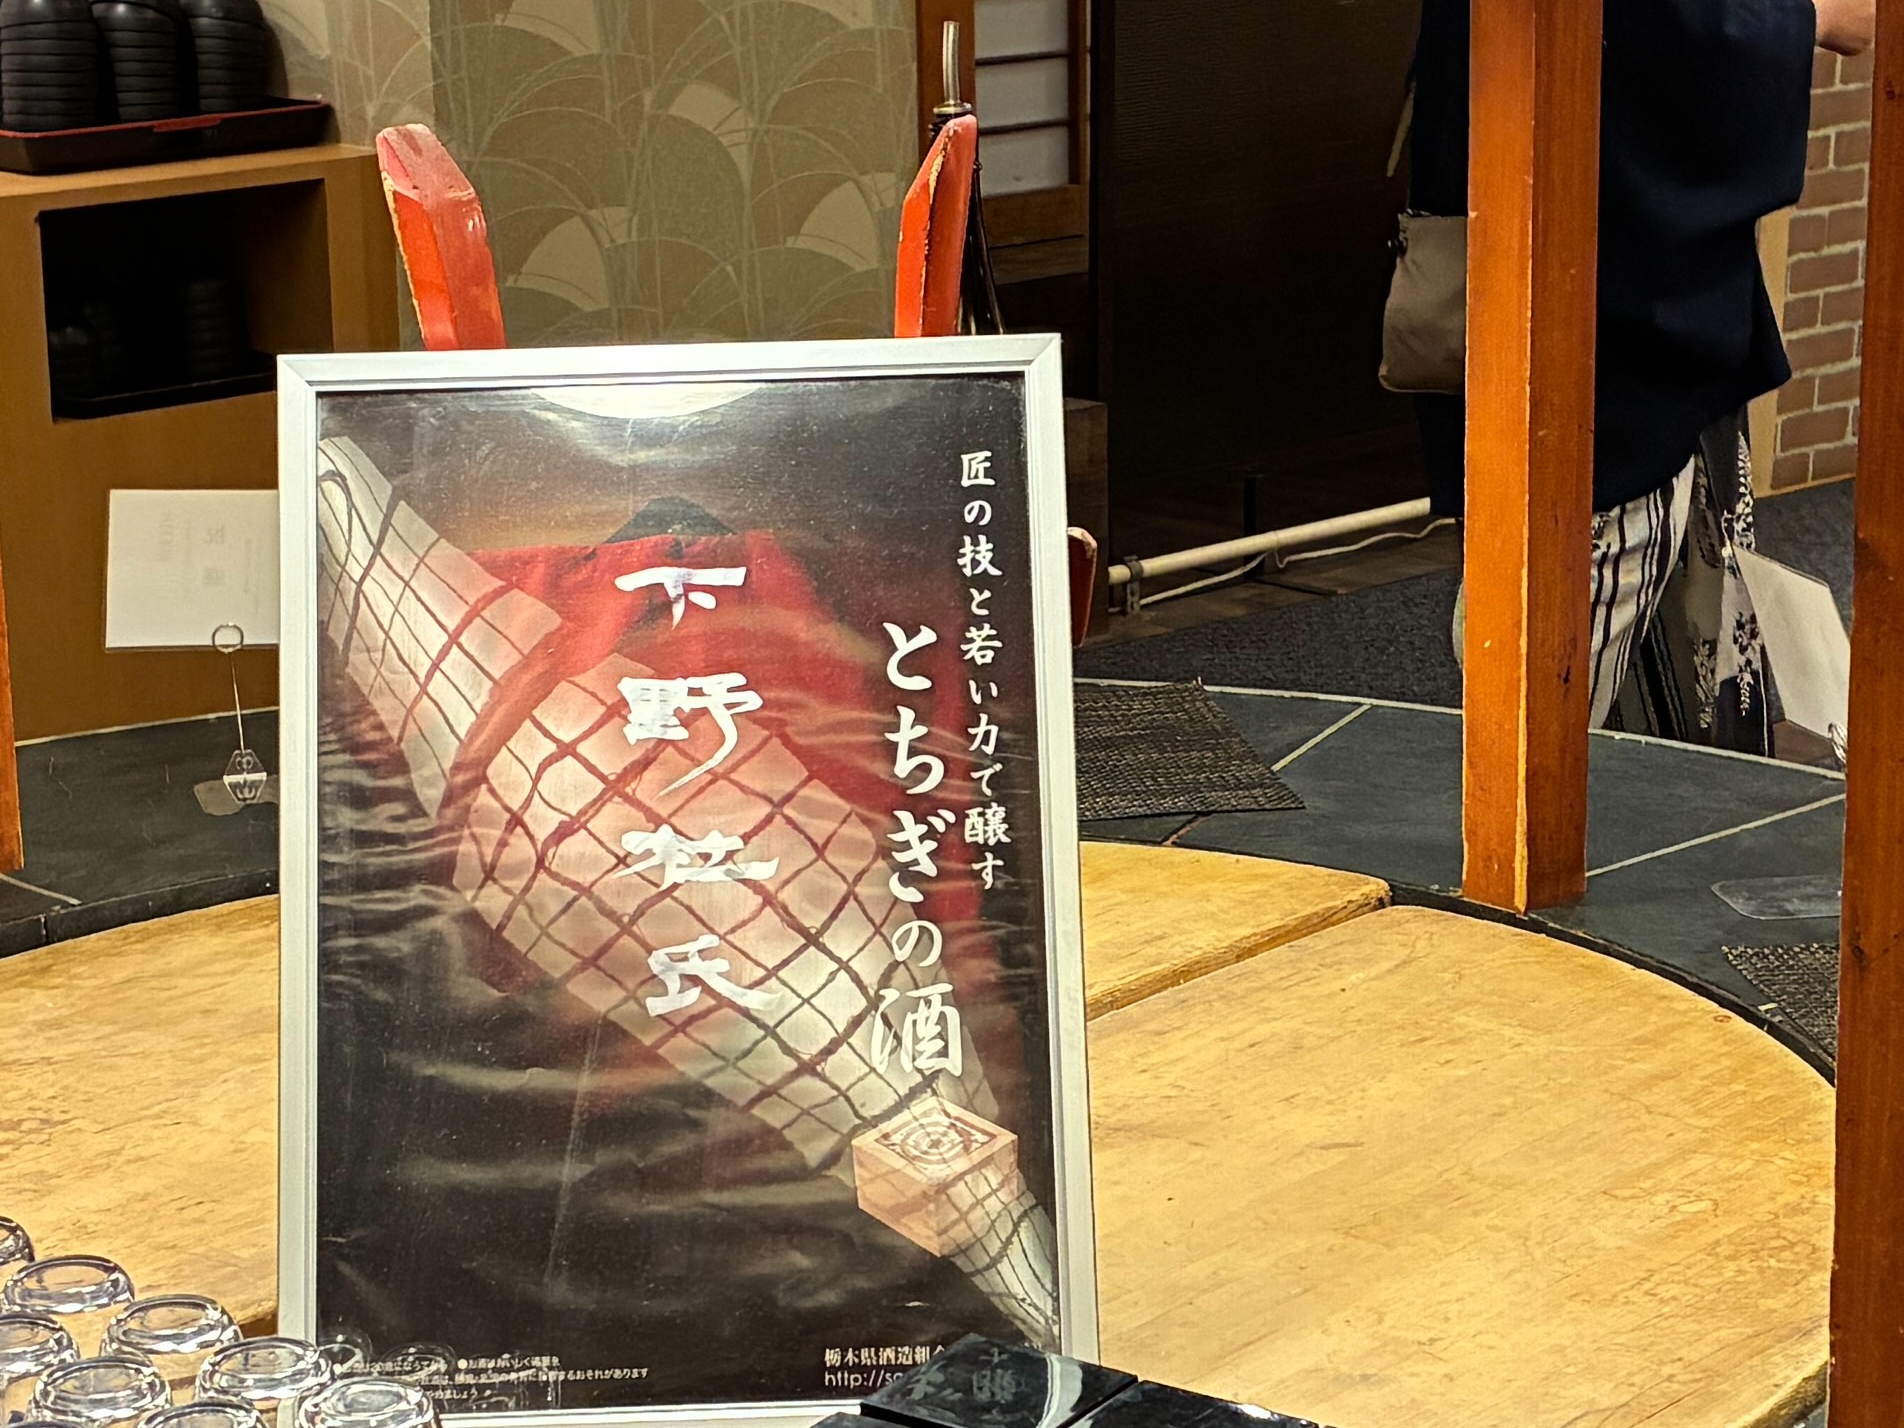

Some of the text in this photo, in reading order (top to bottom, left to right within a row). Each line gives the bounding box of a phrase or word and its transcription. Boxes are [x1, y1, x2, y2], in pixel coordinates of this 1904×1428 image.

[610, 566, 783, 1017] 下野杜氏
[870, 620, 963, 1077] とちぎの酒
[956, 450, 1012, 891] 匠の技と若い力で醸す
